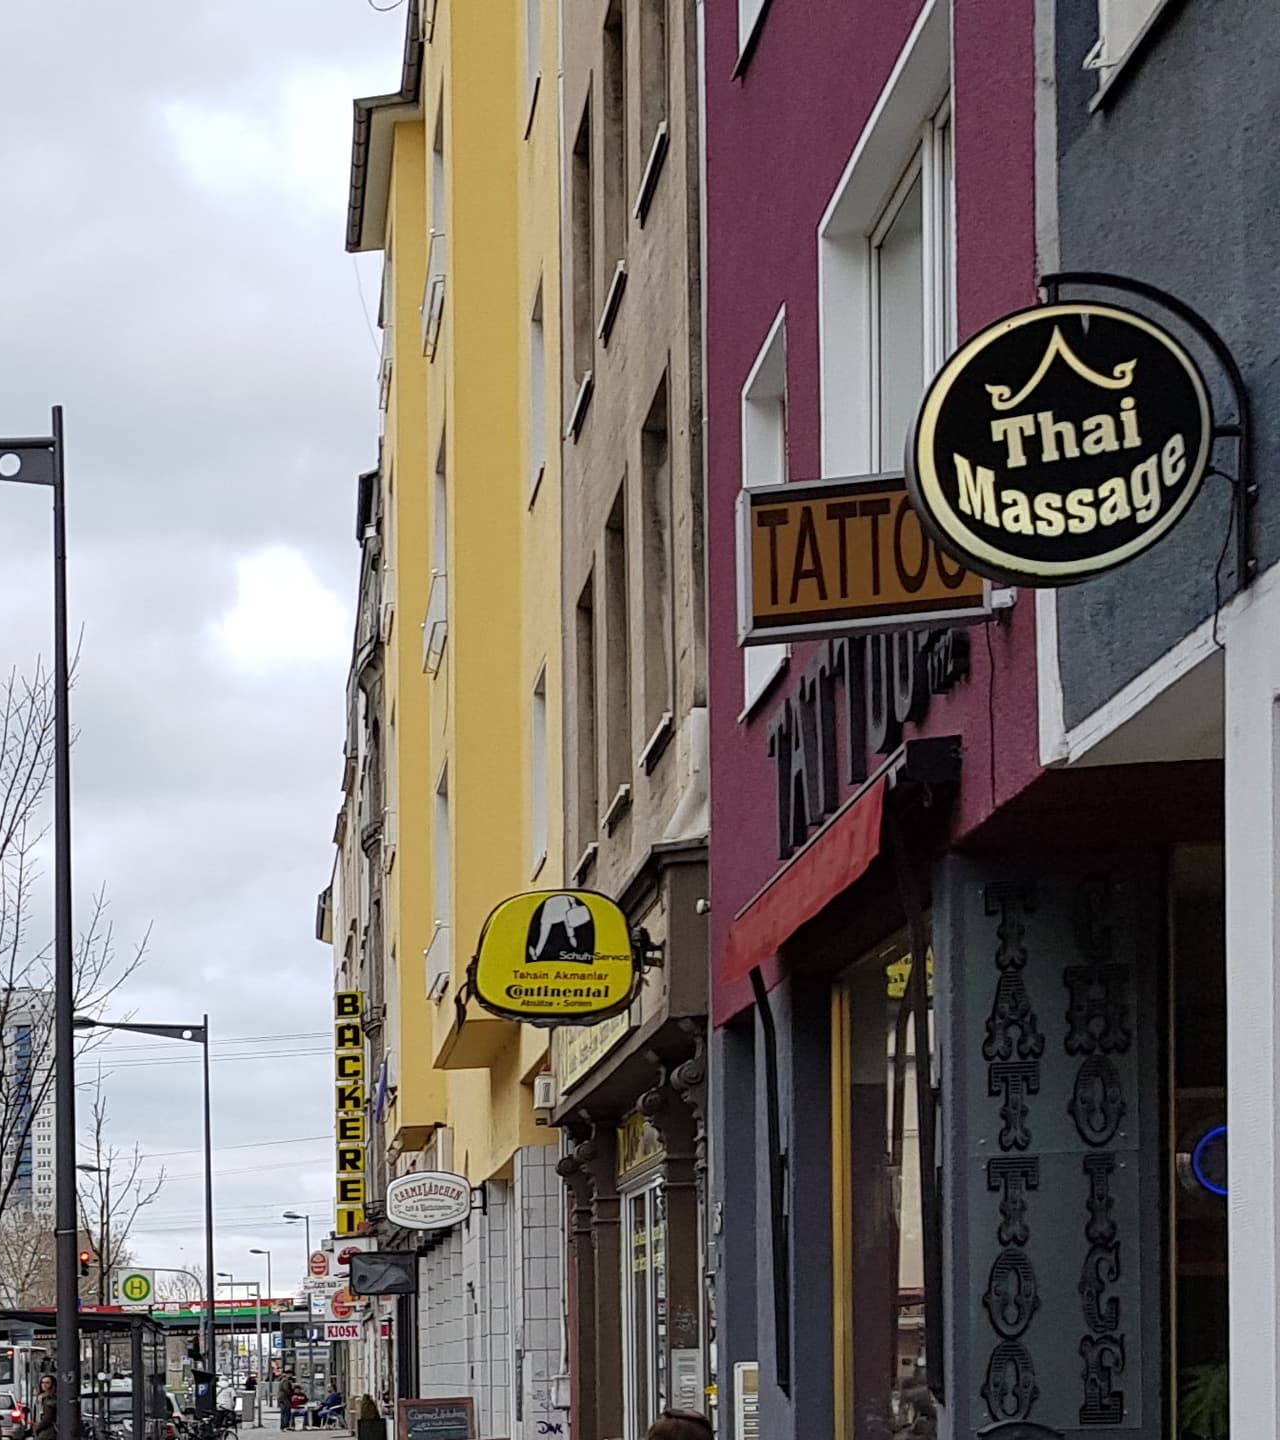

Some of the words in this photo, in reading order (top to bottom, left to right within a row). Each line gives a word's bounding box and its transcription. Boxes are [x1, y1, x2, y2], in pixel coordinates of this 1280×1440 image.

[991, 397, 1143, 470] Thai
[953, 433, 1187, 538] Massage
[505, 984, 610, 999] Continental
[130, 1281, 142, 1295] H
[327, 1325, 359, 1338] KIOSK
